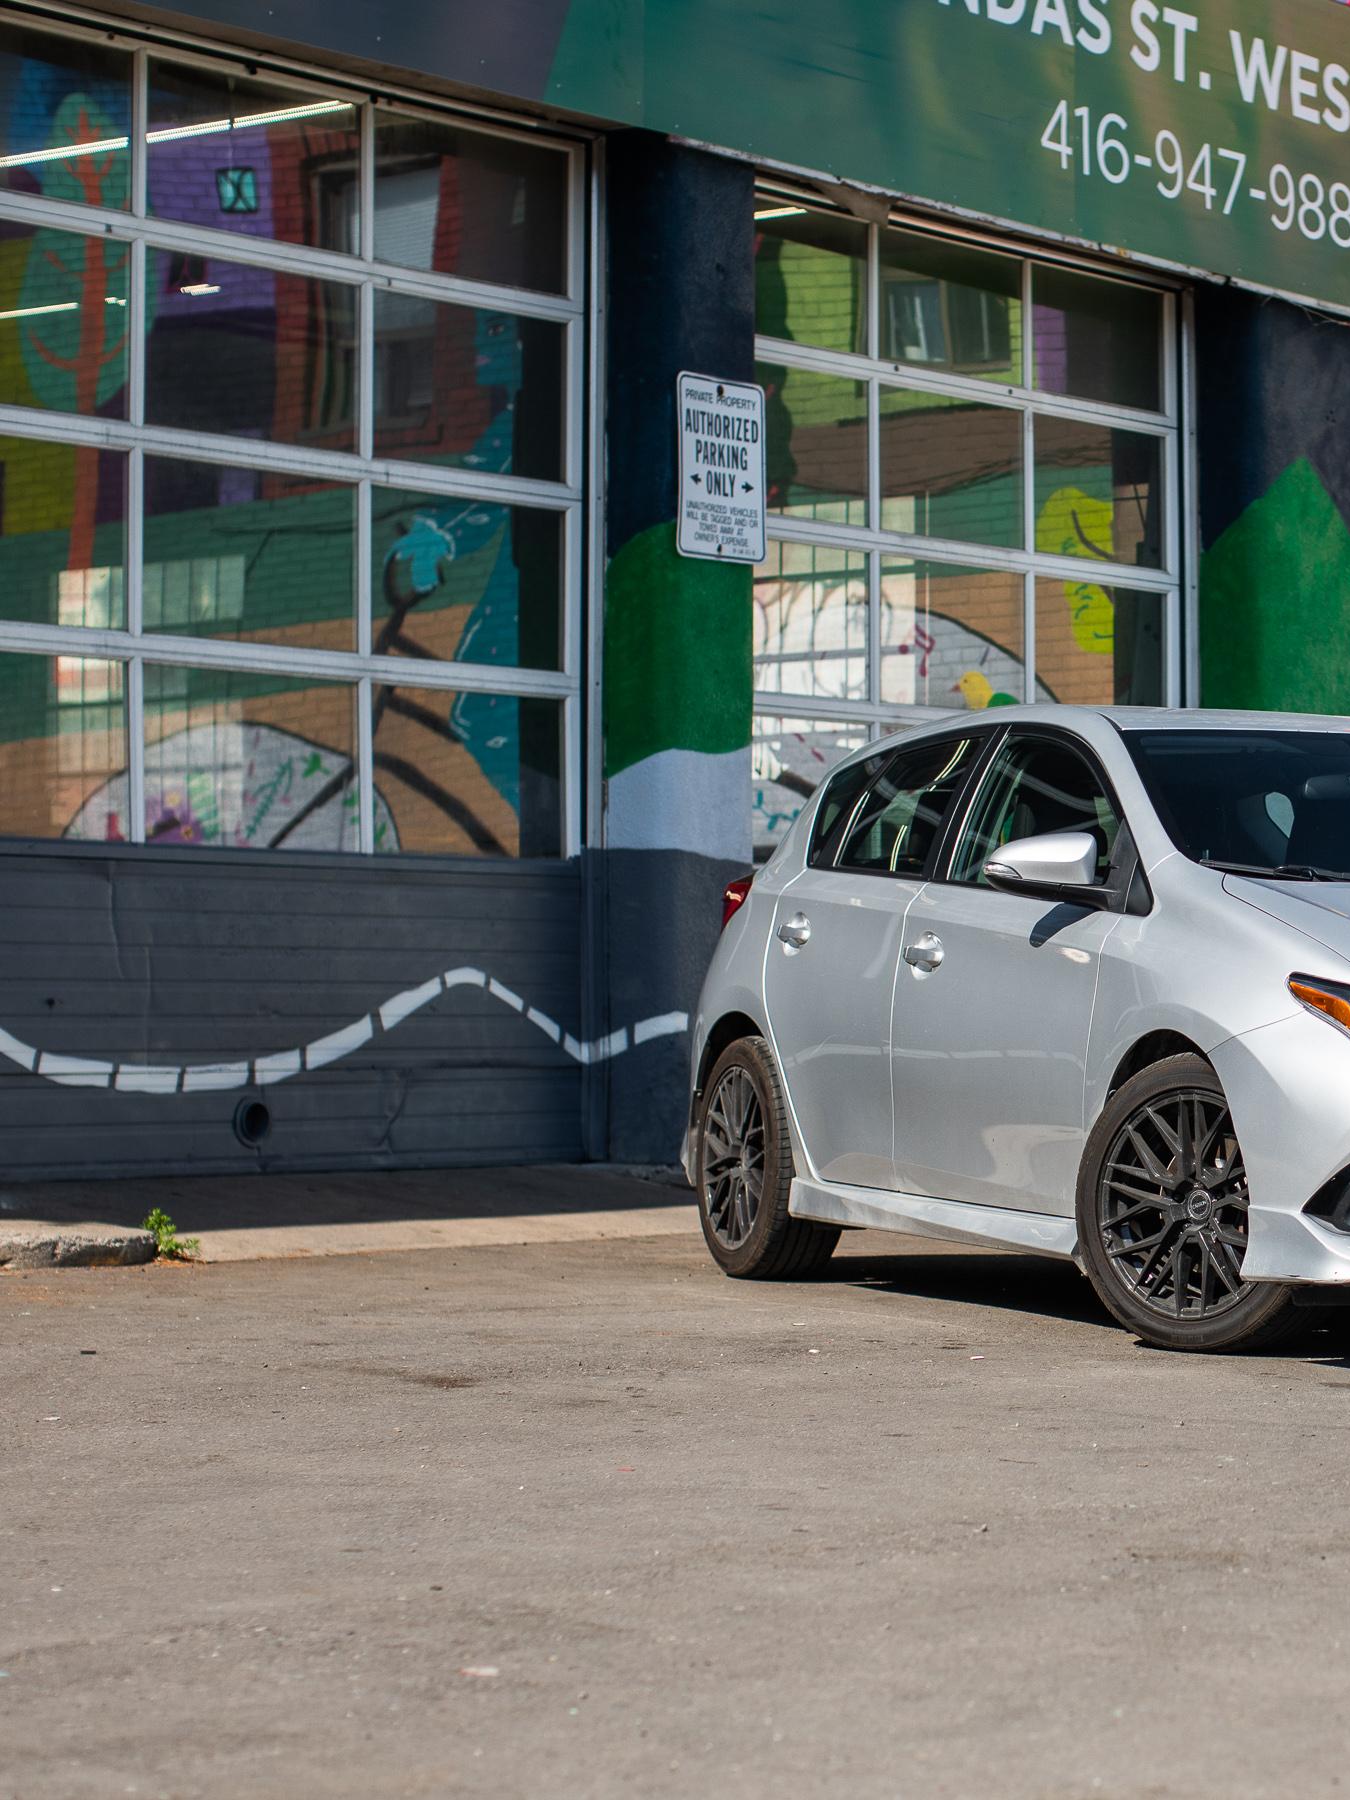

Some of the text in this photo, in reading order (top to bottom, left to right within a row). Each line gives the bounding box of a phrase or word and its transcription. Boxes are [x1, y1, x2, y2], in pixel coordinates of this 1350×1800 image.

[1130, 0, 1211, 91] ST.
[685, 388, 756, 411] PRIVATE PROPERTY
[685, 407, 759, 444] AUTHORIZED
[695, 439, 748, 471] PARKING
[706, 470, 736, 498] ONLY
[686, 500, 758, 518] UNAUTHORIZED VEHICLES
[686, 510, 698, 520] WILL
[701, 513, 708, 521] BE
[710, 514, 732, 525] TAGGED
[699, 522, 717, 533] TOWED
[721, 536, 748, 547] EXPENSE
